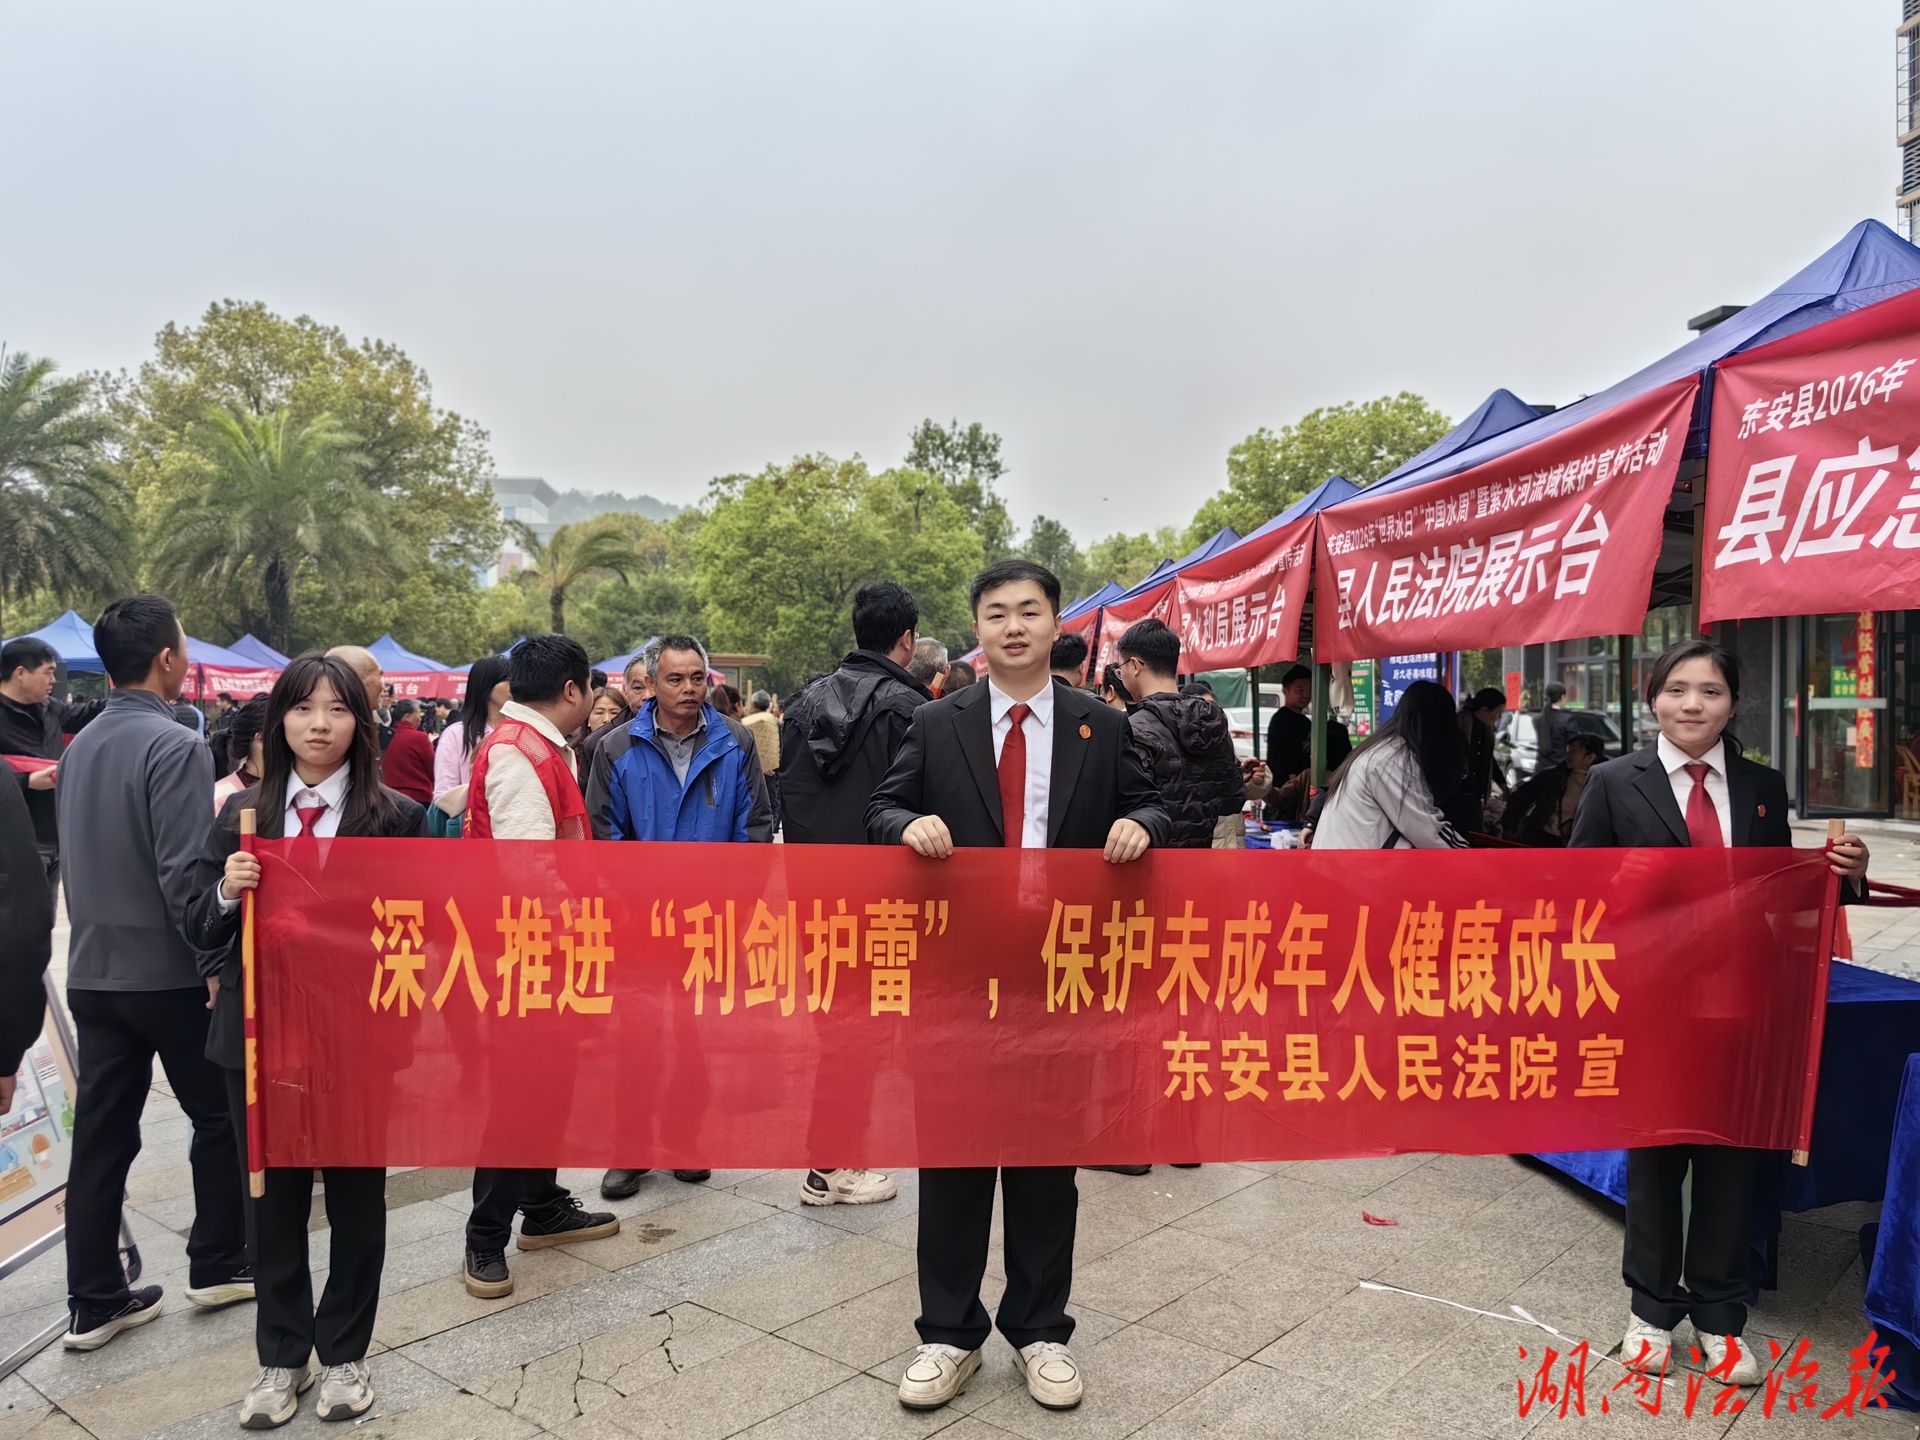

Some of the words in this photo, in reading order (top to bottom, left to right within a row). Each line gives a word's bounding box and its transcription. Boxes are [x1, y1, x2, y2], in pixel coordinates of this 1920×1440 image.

[1738, 358, 1918, 439] 东安县2026年
[1336, 503, 1610, 630] 县人民法院展示台
